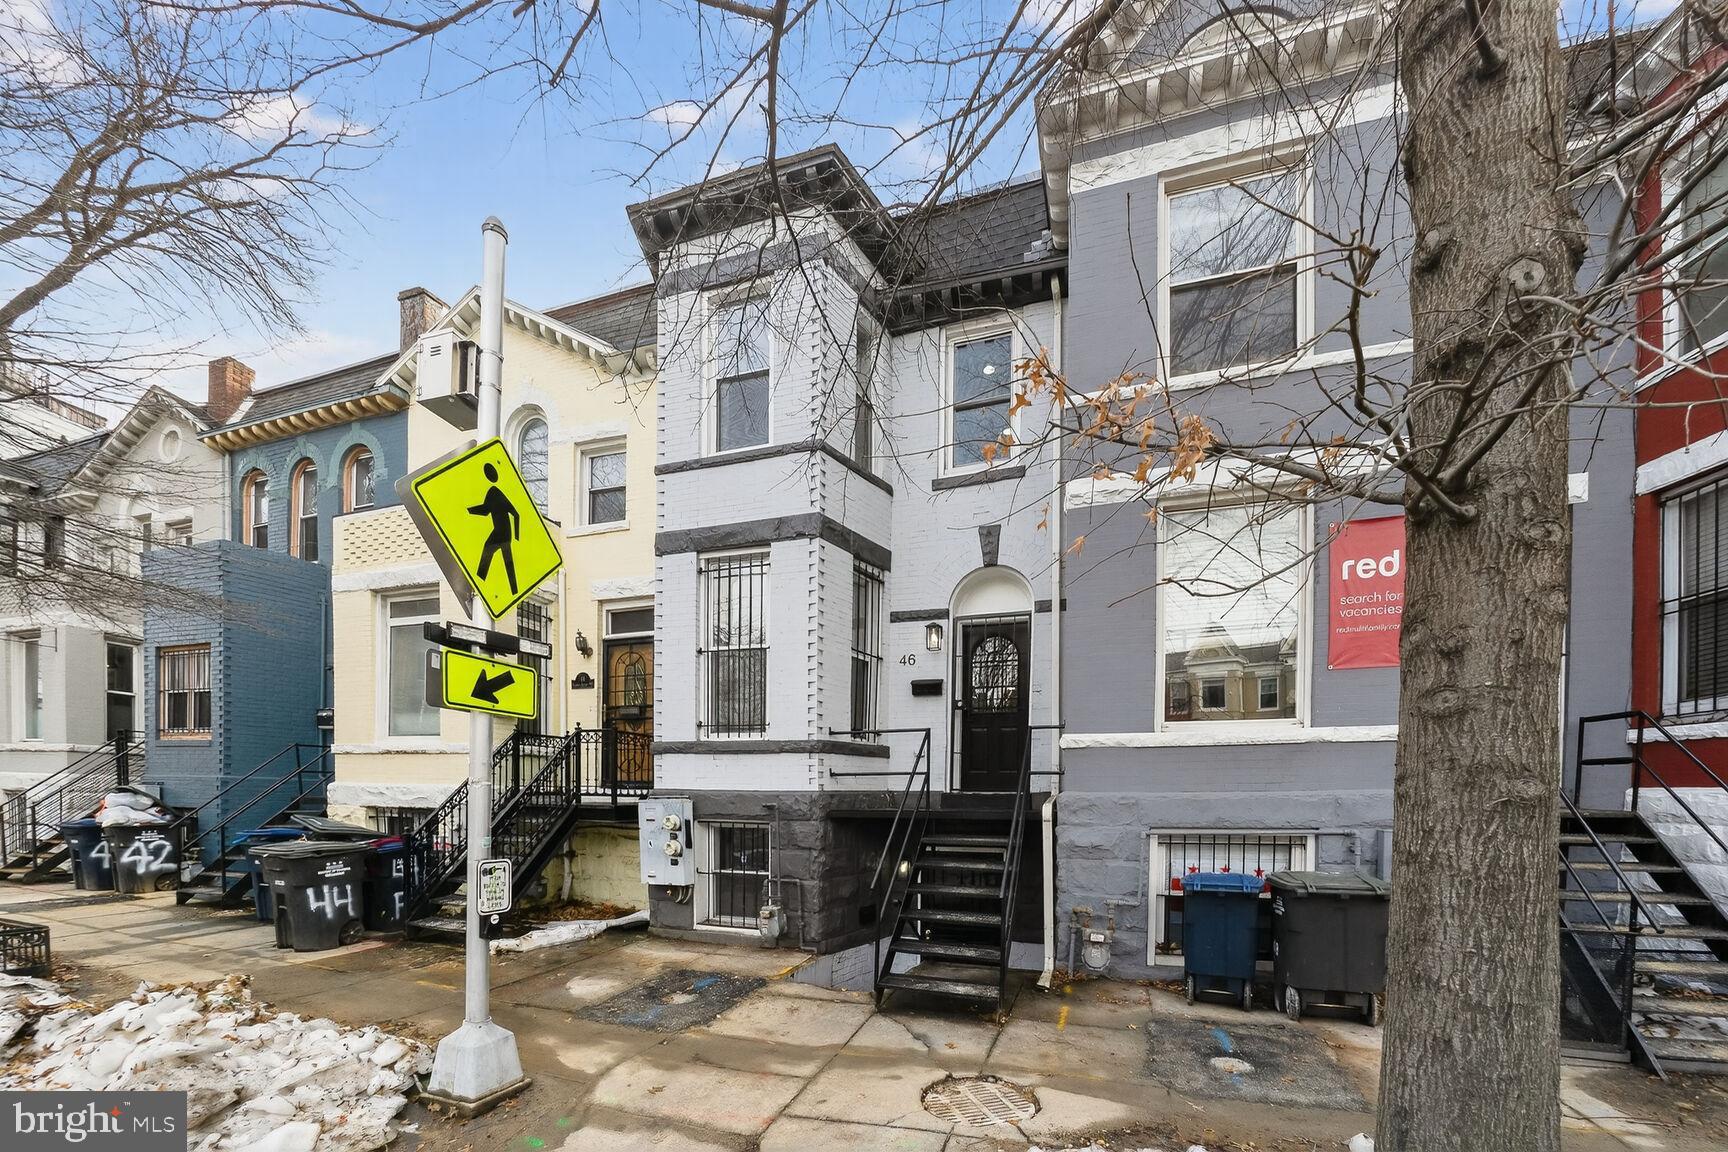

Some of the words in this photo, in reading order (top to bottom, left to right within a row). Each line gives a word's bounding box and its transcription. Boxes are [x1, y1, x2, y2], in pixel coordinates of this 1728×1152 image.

[1342, 549, 1400, 580] red
[1340, 592, 1382, 605] search
[1385, 590, 1403, 601] for
[1340, 604, 1402, 617] vacancies
[899, 653, 916, 666] 46
[120, 840, 177, 875] 42
[306, 884, 355, 919] 44
